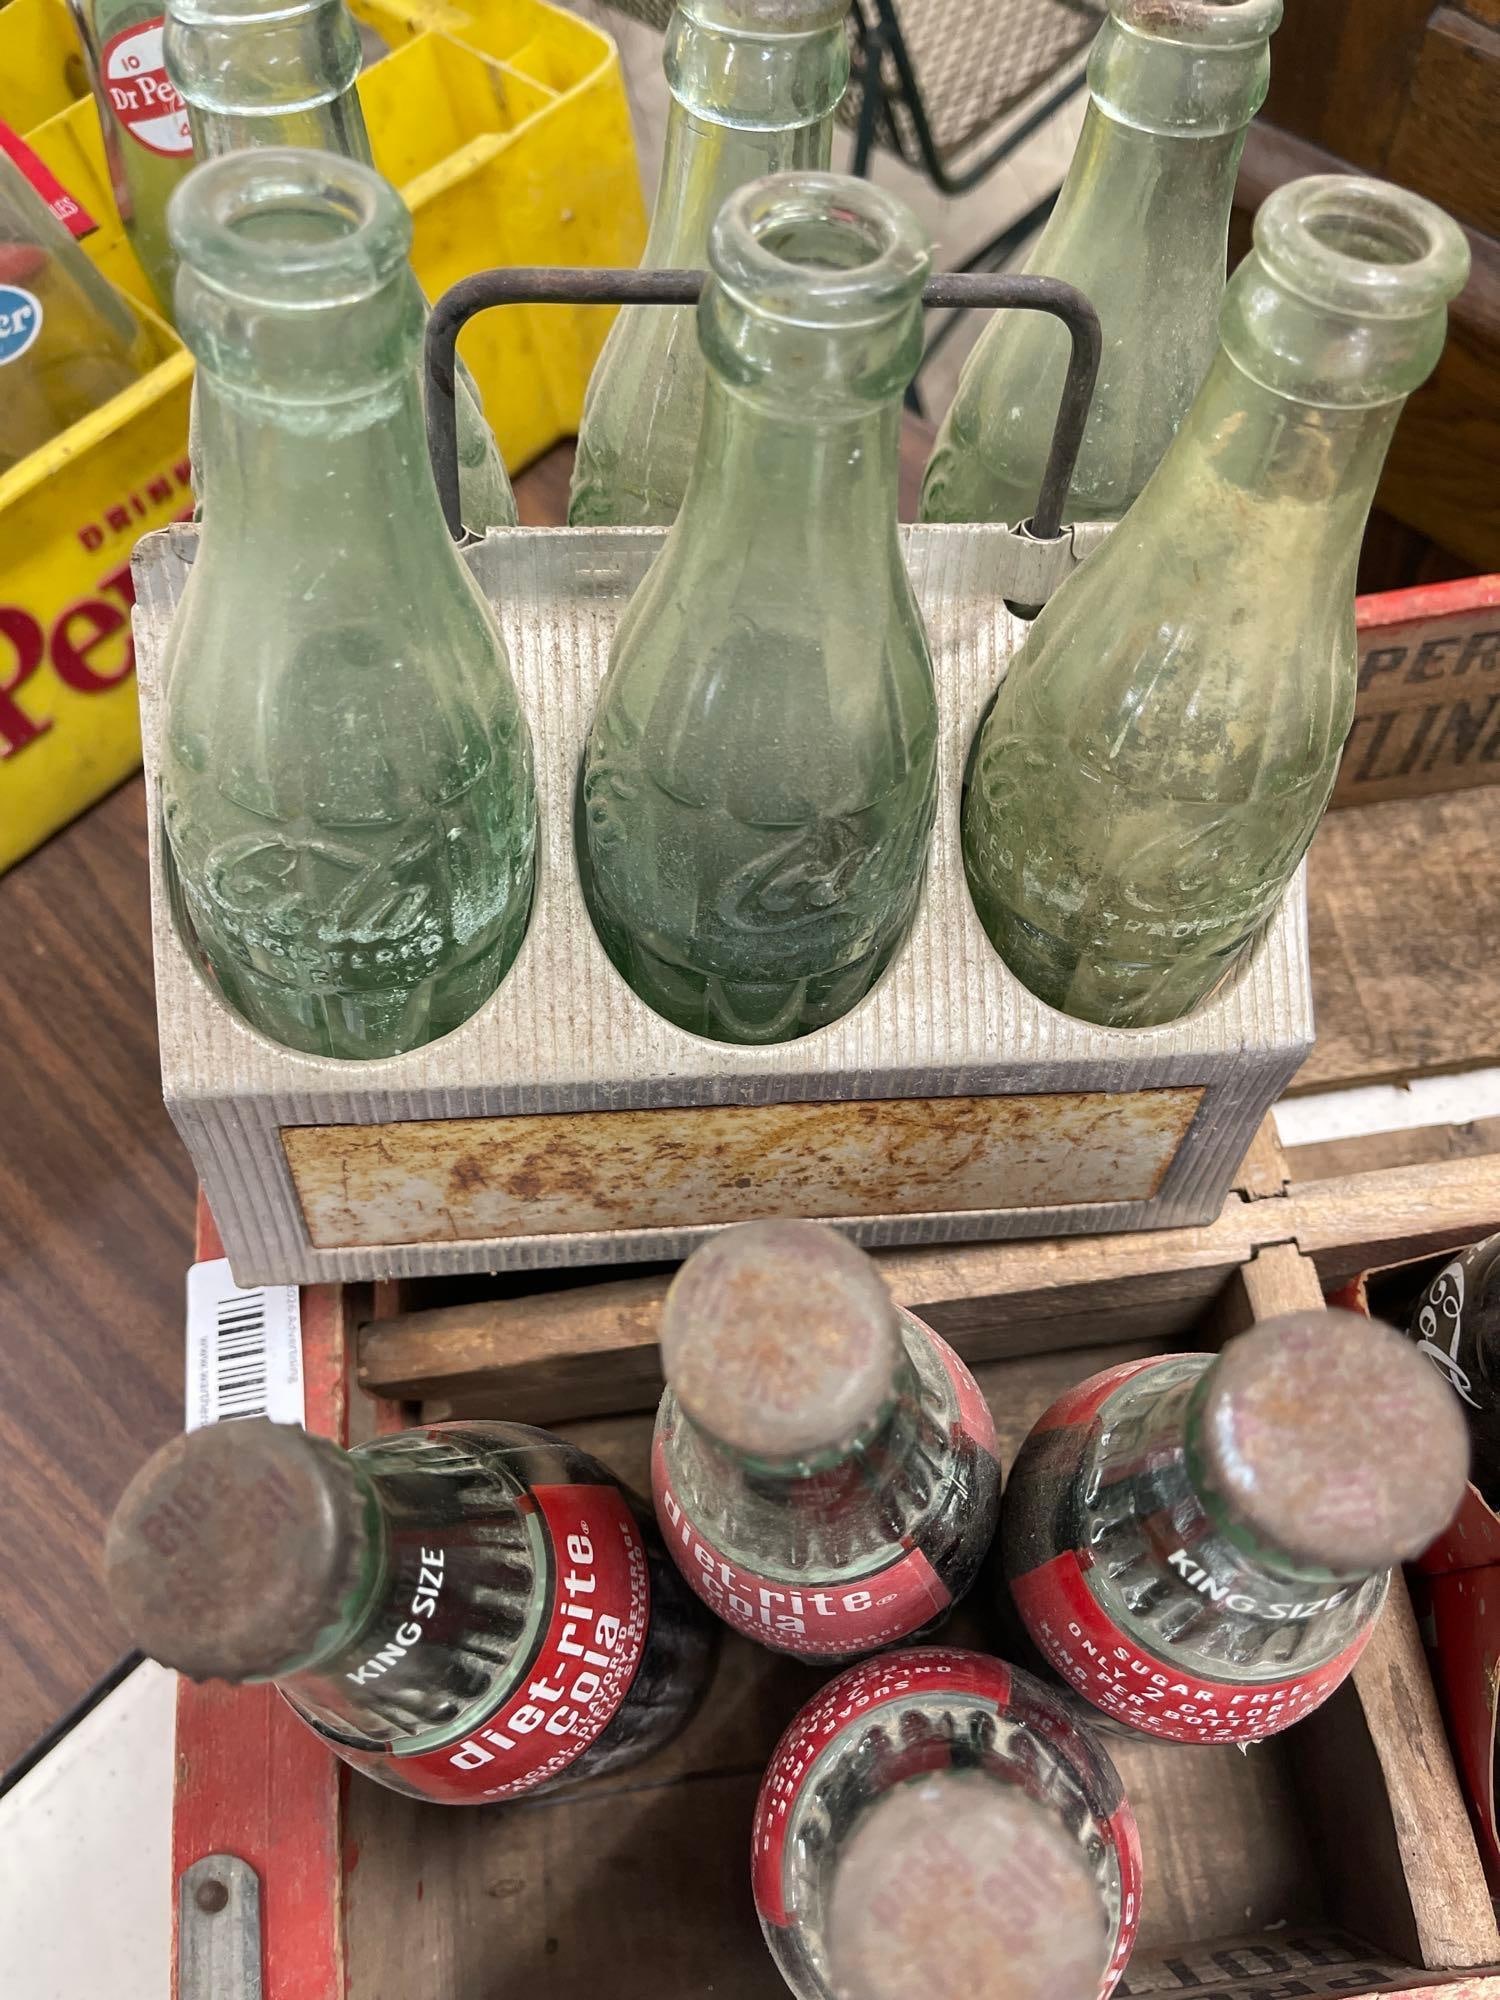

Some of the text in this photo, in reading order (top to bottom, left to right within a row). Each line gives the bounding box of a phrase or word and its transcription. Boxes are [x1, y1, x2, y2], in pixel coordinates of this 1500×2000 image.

[121, 55, 140, 72] 10
[109, 87, 139, 110] Dr
[0, 304, 33, 338] er
[1356, 630, 1500, 692] PER
[619, 1521, 639, 1638] BEVERAGE
[623, 1545, 647, 1677] SWEETENED
[702, 1571, 807, 1634] cola
[1168, 1549, 1349, 1620] KING SIZE
[346, 1546, 445, 1685] KING SIZE
[545, 1614, 620, 1737] cola
[568, 1626, 628, 1736] FLAVORED
[846, 1688, 865, 1702] 2
[852, 1664, 898, 1688] PER
[880, 1665, 952, 1684] ONLY
[1040, 1620, 1089, 1681] KING
[1102, 1691, 1163, 1726] SIZE
[1198, 1727, 1233, 1737] 12
[1067, 1622, 1128, 1680] ONLY
[1140, 1686, 1166, 1703] 2
[1178, 1681, 1330, 1719] CALORIES
[1096, 1671, 1146, 1707] PER
[1162, 1710, 1281, 1728] BOTTLE
[1112, 1646, 1305, 1705] SUGAR FREE
[777, 1679, 910, 1817] SUGAR FREE
